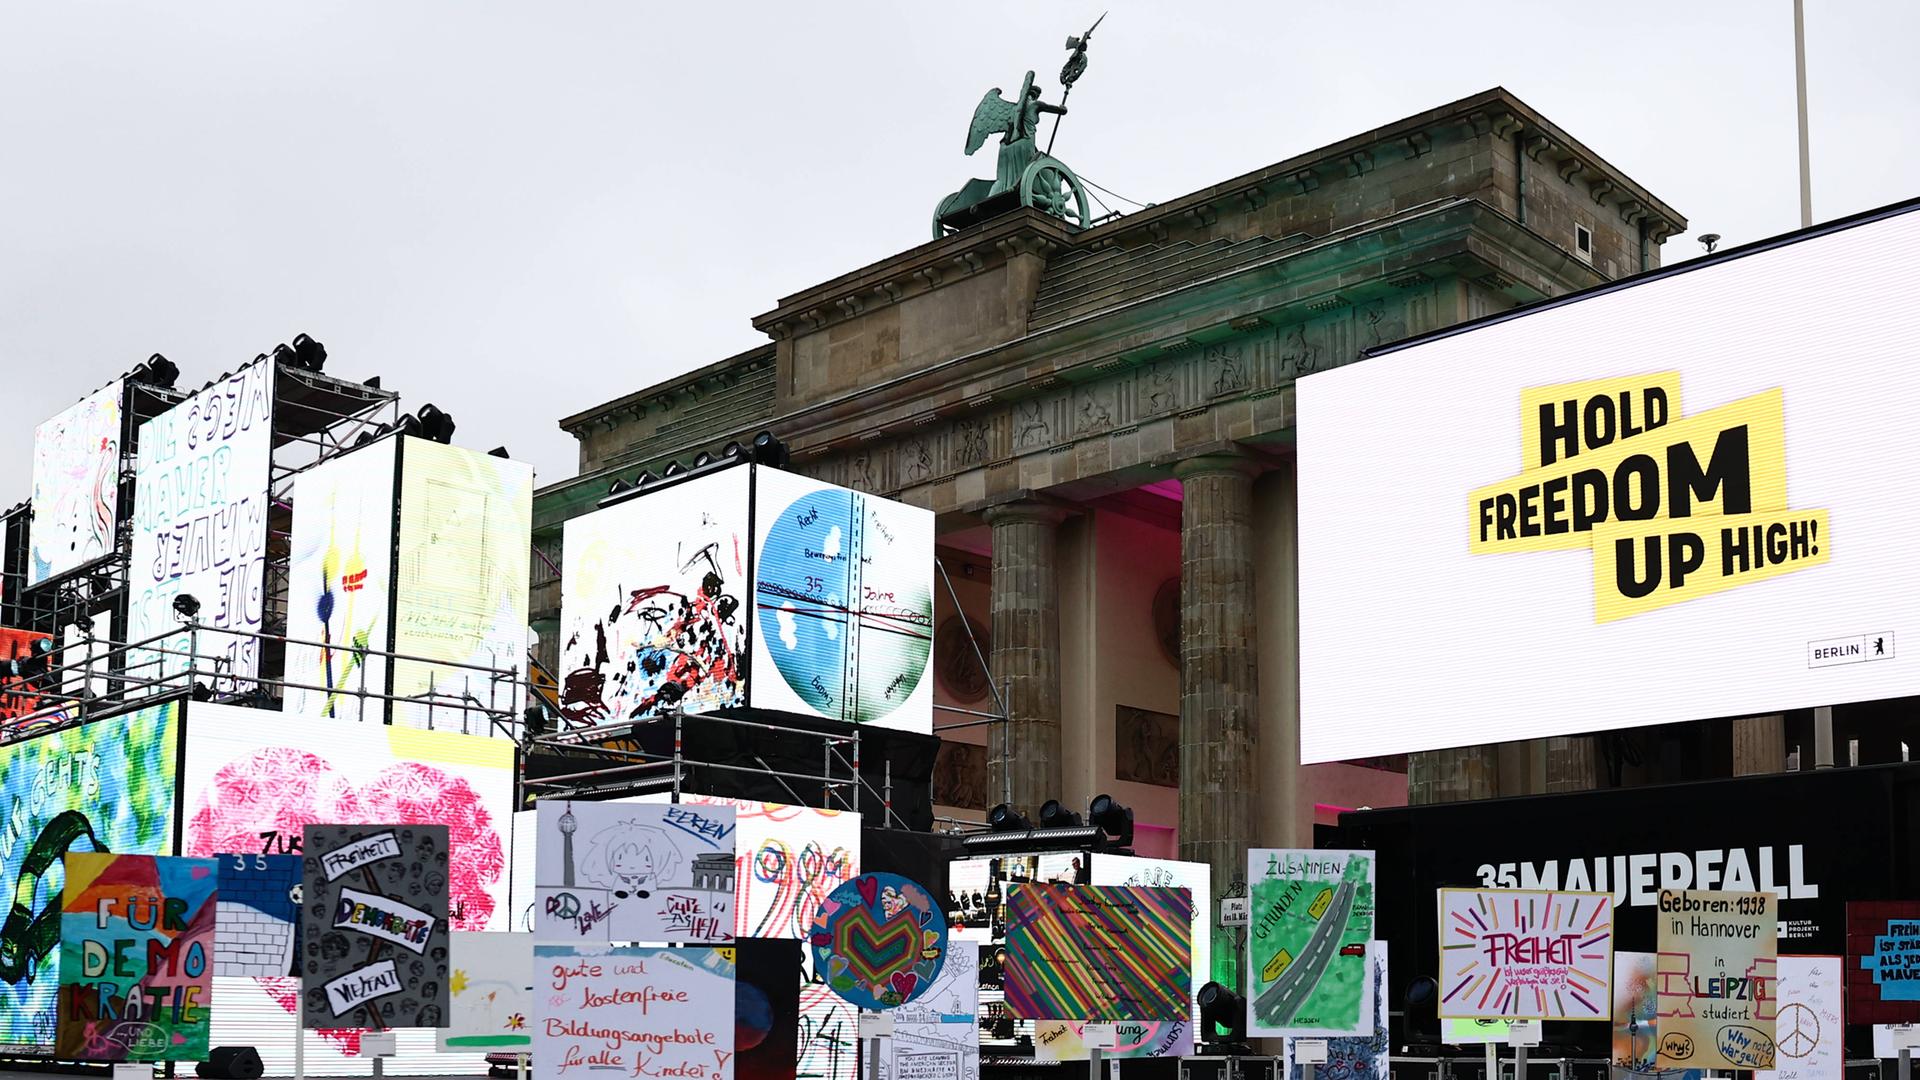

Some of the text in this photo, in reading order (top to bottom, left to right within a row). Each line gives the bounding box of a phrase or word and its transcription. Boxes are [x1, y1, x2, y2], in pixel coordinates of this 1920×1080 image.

[138, 405, 176, 475] DIE
[1539, 387, 1669, 468] HOLD
[1480, 424, 1752, 542] FREEDOM
[797, 506, 819, 530] Recht
[1615, 519, 1819, 599] UP HIGH!
[215, 556, 266, 629] DIE
[804, 576, 896, 604] 35 Jahre
[1814, 644, 1860, 660] BERLIN
[1520, 844, 1819, 907] MAUERFALL
[96, 895, 188, 932] FÜR
[1255, 880, 1304, 940] GEFUNDEN
[1736, 896, 1766, 915] 1998
[1671, 915, 1761, 939] in Hannover
[81, 938, 207, 979] DEMO
[1482, 932, 1583, 967] FREIHEIT
[1714, 956, 1725, 968] in
[1879, 955, 1902, 967] ALS
[551, 958, 649, 991] gute und
[69, 982, 203, 1025] KRATIE
[579, 986, 690, 1016] kostenfreie
[1701, 1003, 1751, 1021] studiert
[127, 1037, 165, 1049] LIEBE
[542, 1017, 717, 1056] Bildungsangebote
[1728, 1029, 1750, 1048] Why
[588, 1050, 625, 1067] alle
